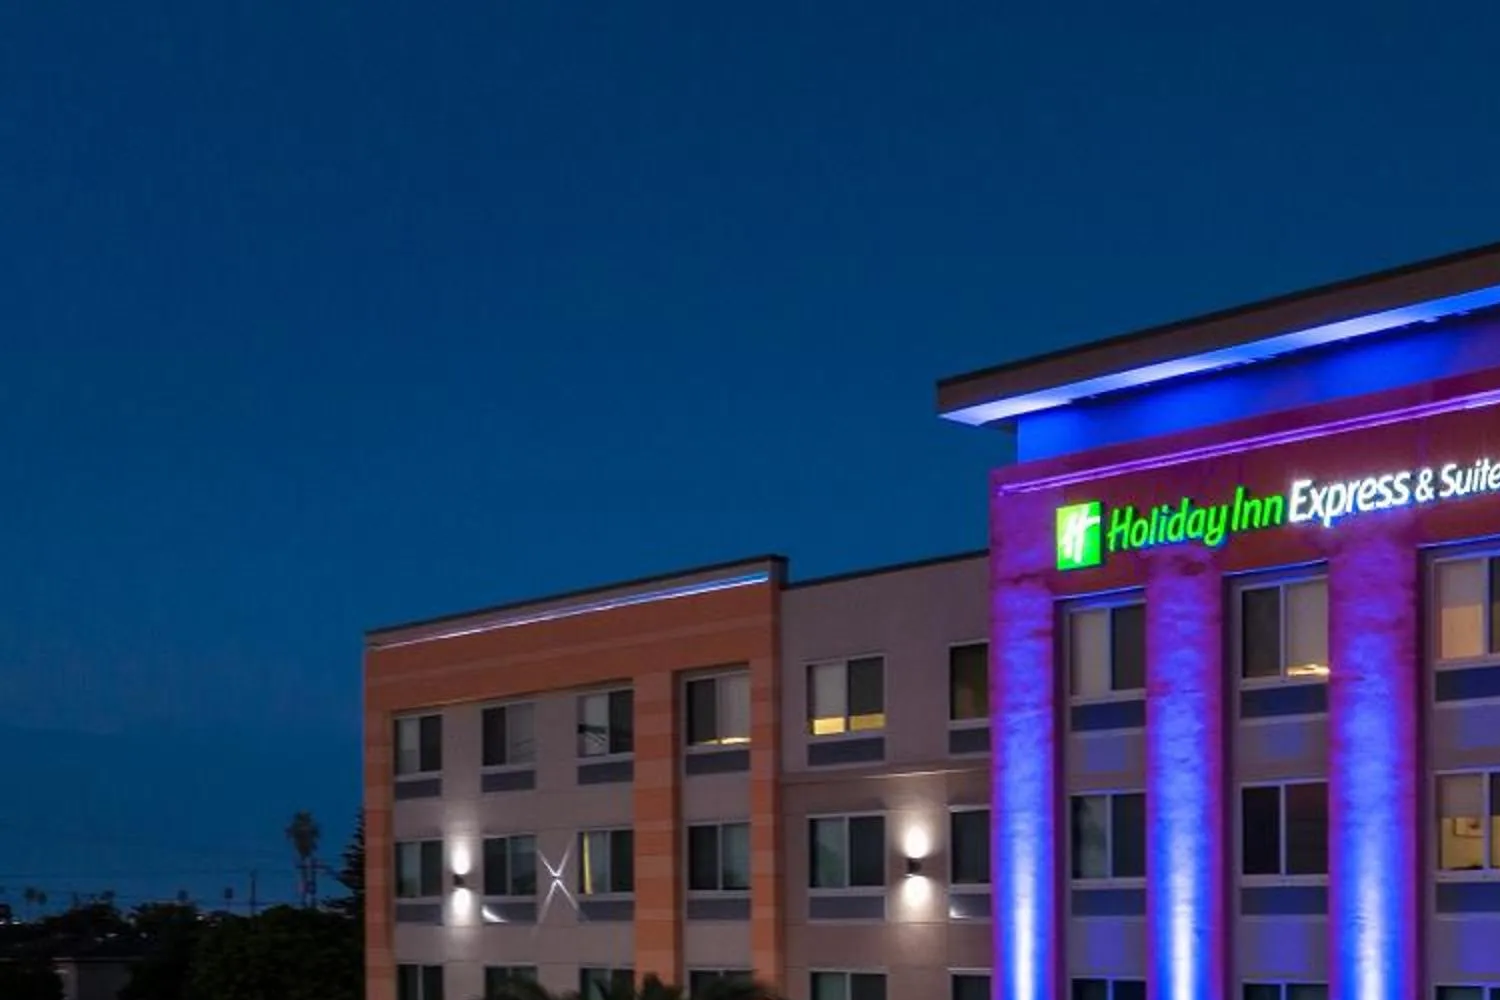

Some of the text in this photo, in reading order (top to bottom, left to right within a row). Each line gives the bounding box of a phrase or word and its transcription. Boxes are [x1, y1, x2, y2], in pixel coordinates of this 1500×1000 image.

[1107, 496, 1229, 552] Holiday
[1230, 485, 1285, 532] Inn
[1287, 474, 1412, 527] Express
[1416, 466, 1435, 502] &
